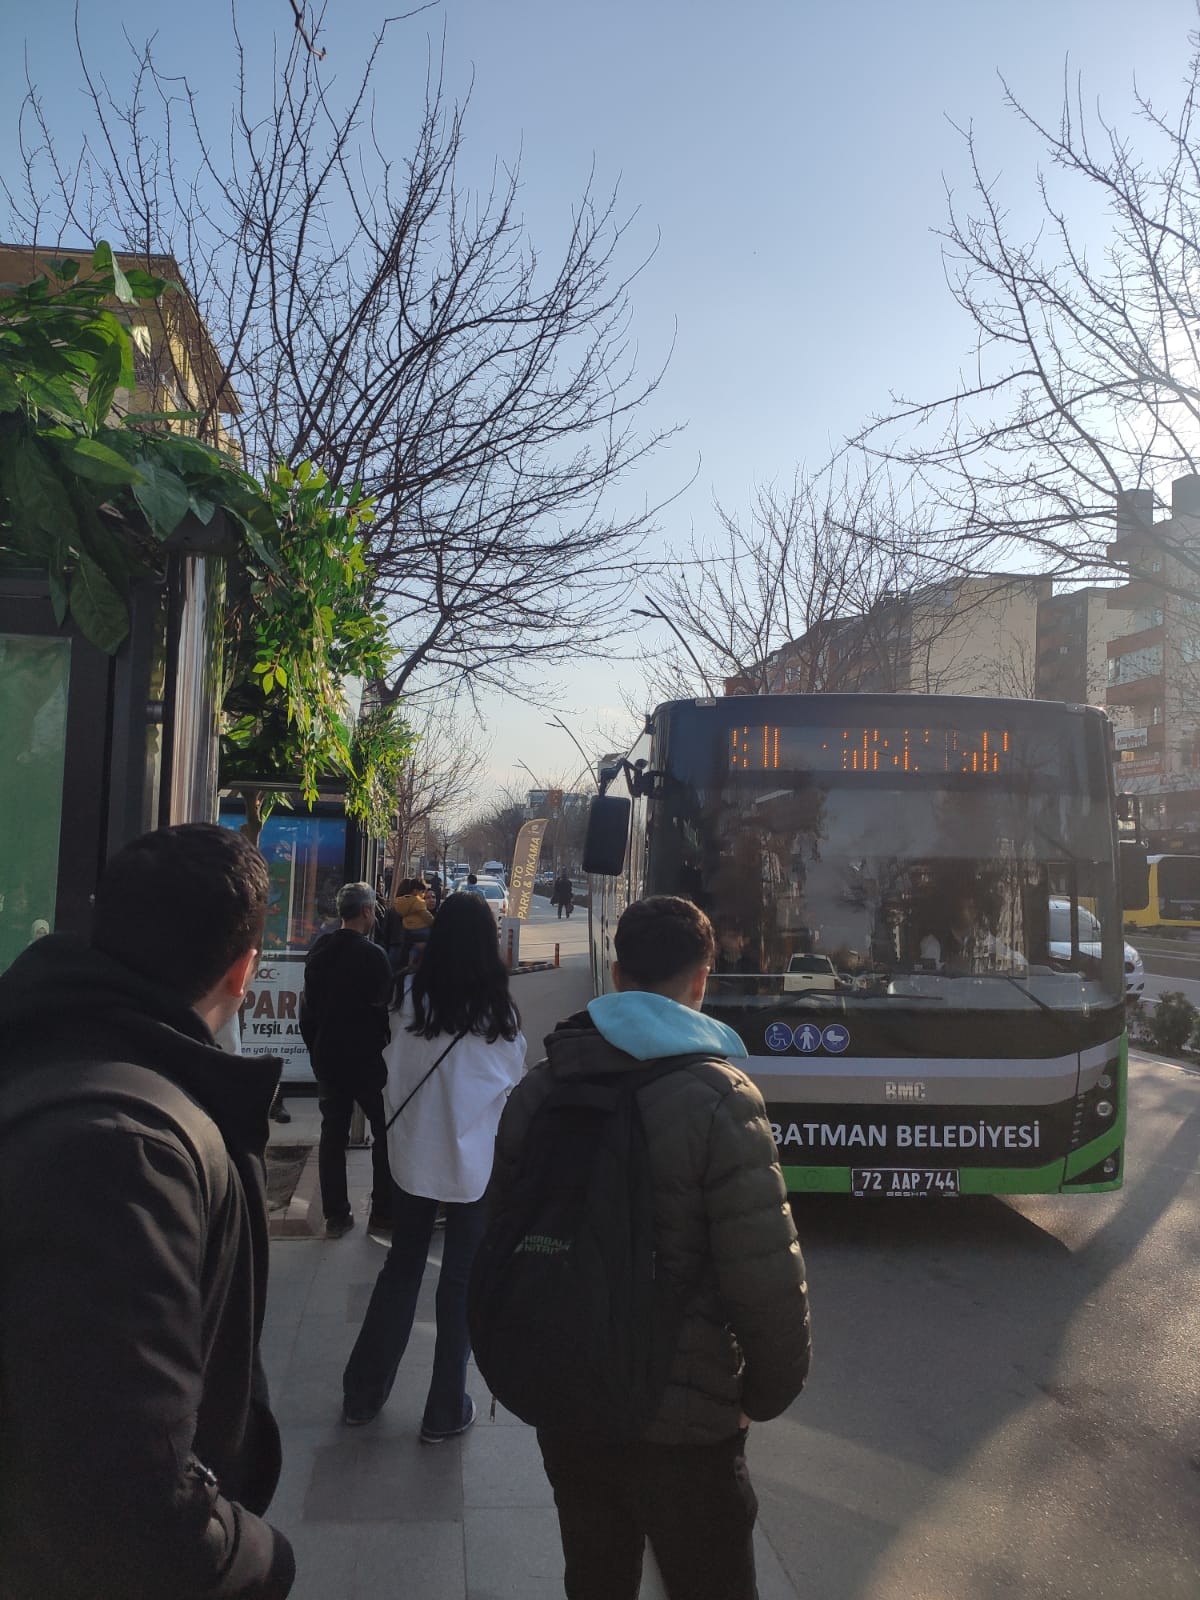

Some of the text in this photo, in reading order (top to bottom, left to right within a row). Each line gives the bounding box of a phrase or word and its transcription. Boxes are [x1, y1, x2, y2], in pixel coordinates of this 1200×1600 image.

[513, 866, 523, 887] OTO
[518, 891, 530, 919] PARK
[252, 1021, 282, 1037] YEŞİL
[286, 1024, 302, 1035] AL
[885, 1082, 926, 1100] BMC
[770, 1120, 1039, 1148] BATMAN BELEDİYESİ
[862, 1172, 955, 1190] 72 AAP 744
